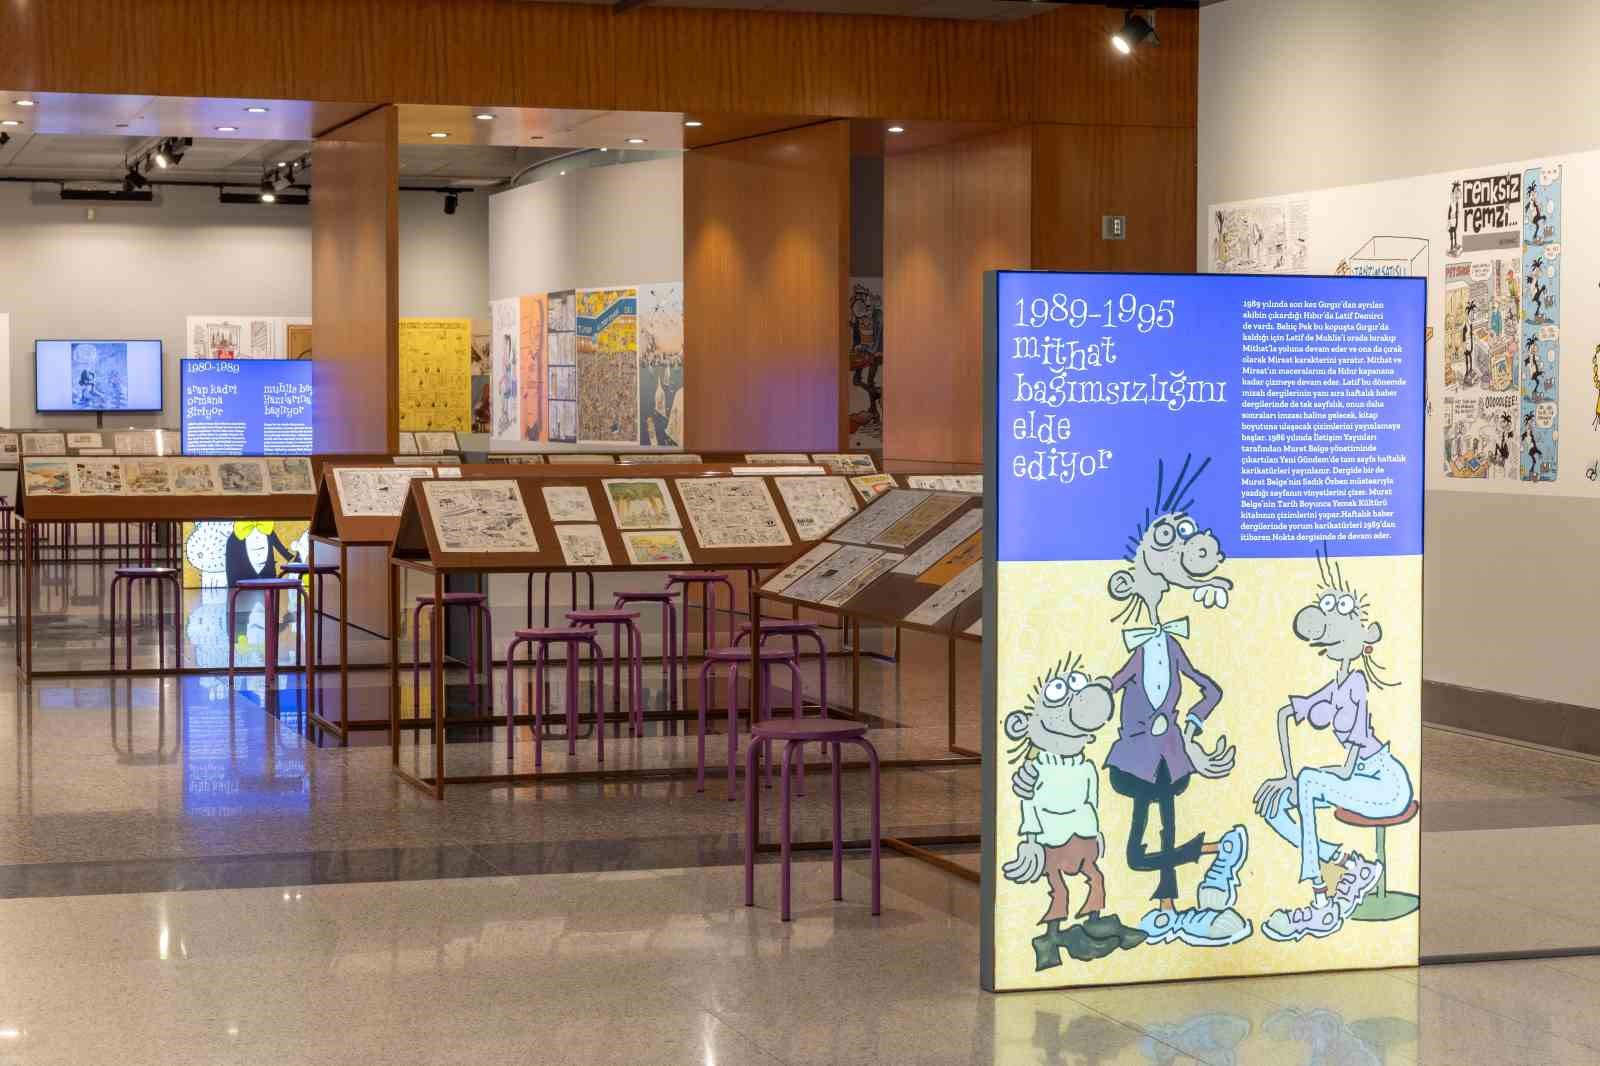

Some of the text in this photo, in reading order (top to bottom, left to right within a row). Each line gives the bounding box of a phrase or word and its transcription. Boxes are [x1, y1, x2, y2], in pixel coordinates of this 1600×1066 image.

[1463, 172, 1520, 204] renksiz
[1015, 293, 1175, 333] 1989-1995
[1012, 334, 1117, 371] mithat
[1012, 366, 1227, 411] bağımsızlığını
[1012, 410, 1071, 444] elde
[1012, 447, 1113, 483] ediyor
